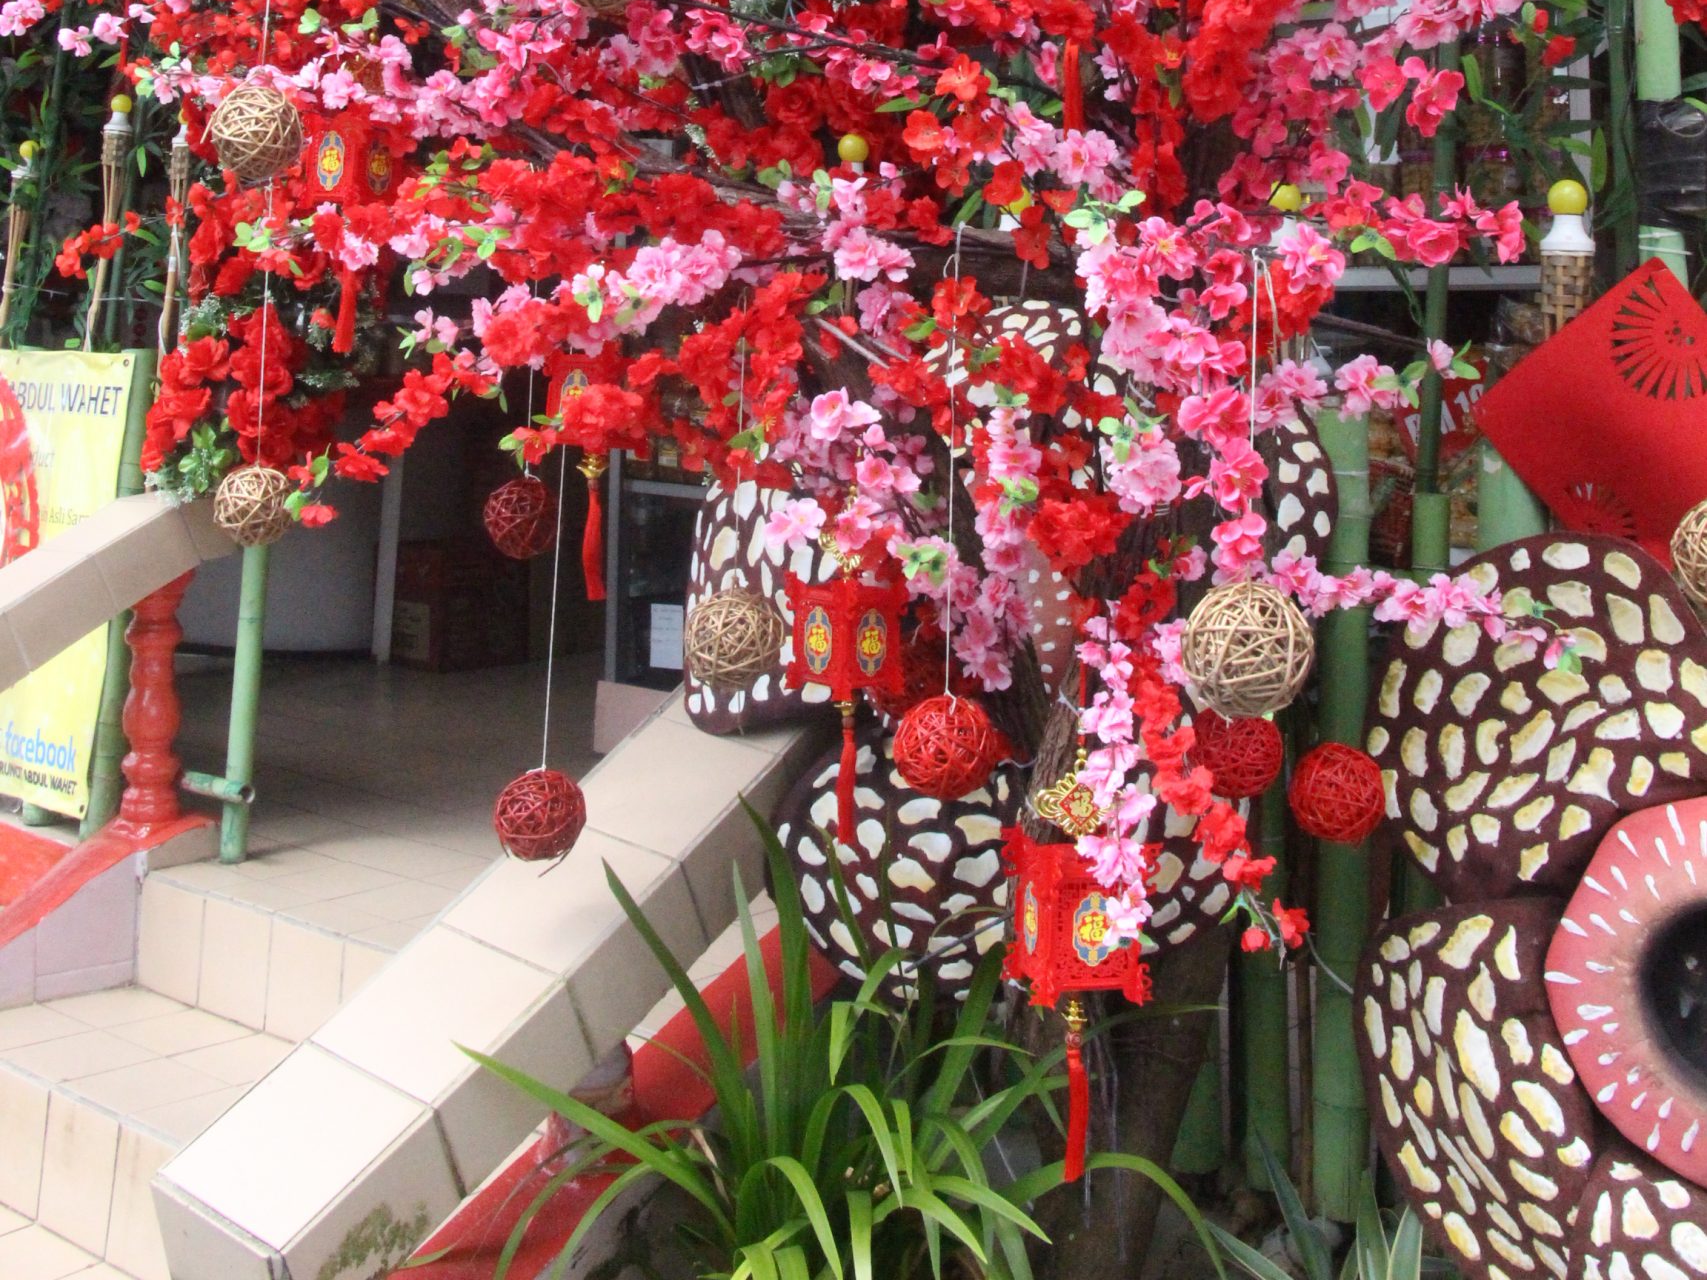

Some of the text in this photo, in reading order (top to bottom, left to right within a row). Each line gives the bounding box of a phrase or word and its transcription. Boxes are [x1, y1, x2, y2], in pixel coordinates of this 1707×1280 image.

[9, 381, 122, 416] BDUL WAHET
[5, 720, 77, 773] facebook
[49, 775, 78, 796] WAHET
